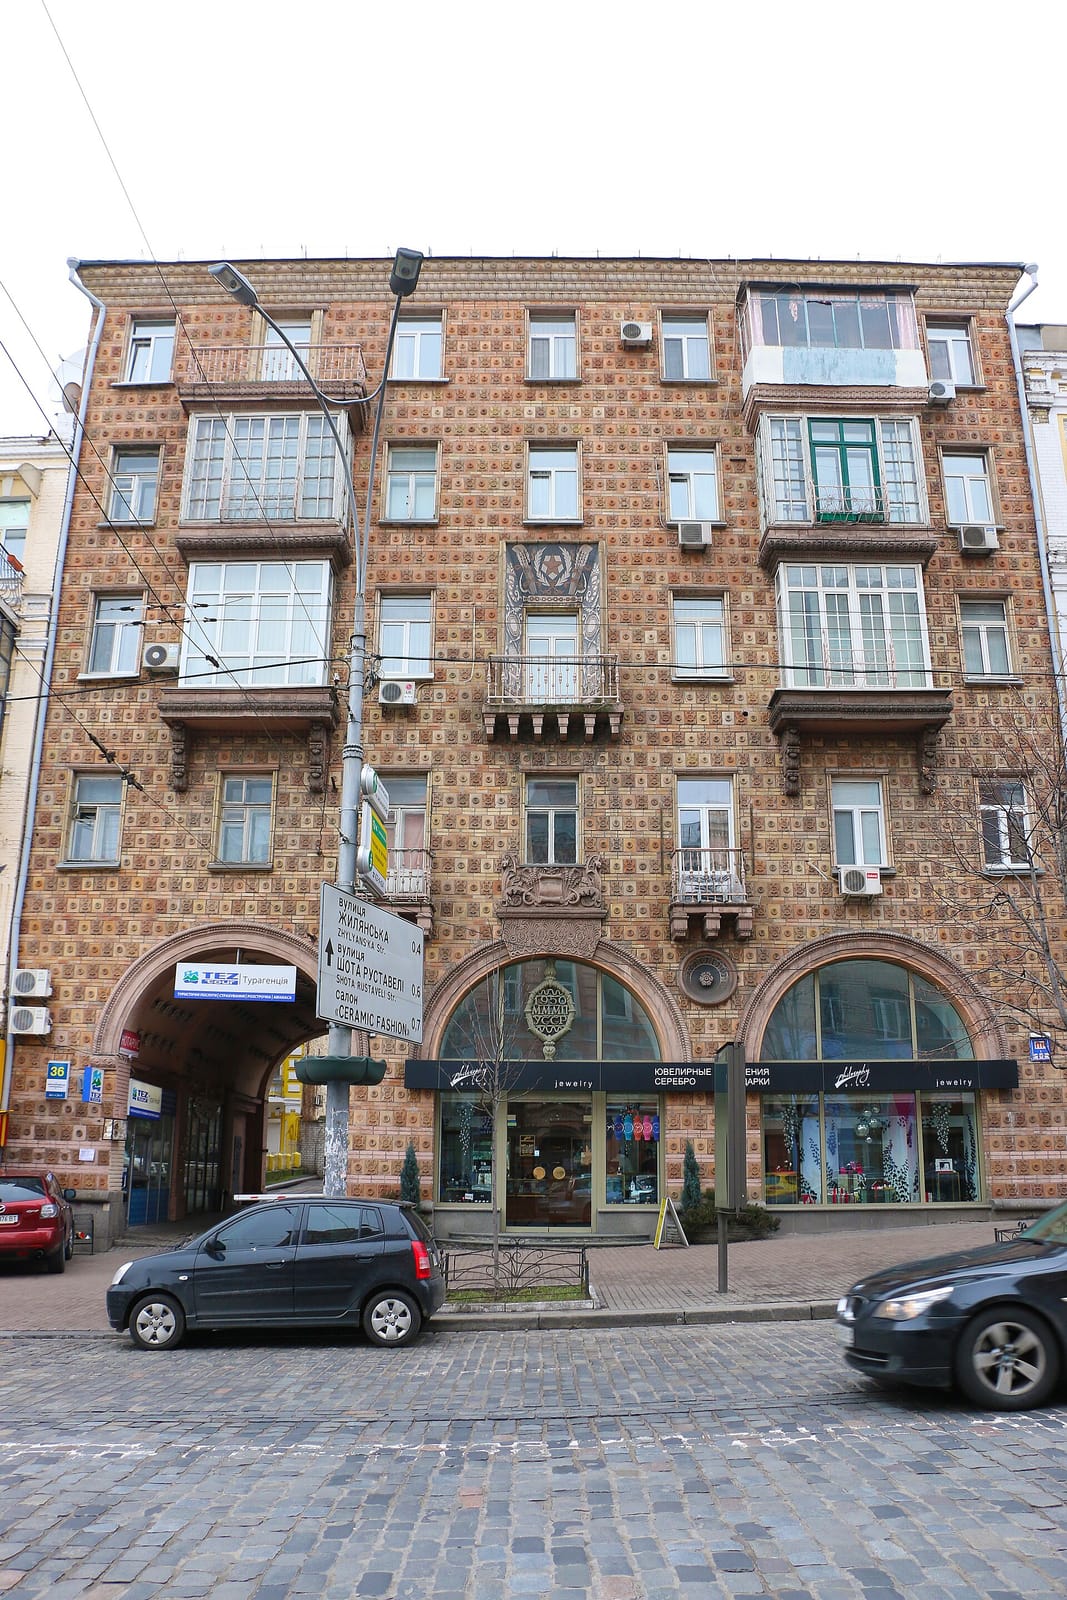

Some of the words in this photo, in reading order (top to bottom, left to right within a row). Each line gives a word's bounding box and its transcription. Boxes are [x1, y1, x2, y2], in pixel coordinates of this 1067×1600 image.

[338, 897, 366, 916] вулиця
[338, 911, 390, 944] ЖИЛЯНСЬКА
[337, 943, 365, 962] вулиця
[202, 971, 239, 980] TEZ
[336, 957, 362, 978] ШОТА
[363, 968, 405, 992] РУСТАВЕЛІ
[242, 975, 288, 986] Турагенція
[336, 974, 355, 989] SHOTA
[357, 981, 386, 999] RUSTAVELI
[335, 989, 358, 1005] салон
[532, 1014, 567, 1025] УССР
[50, 1066, 65, 1077] 36
[654, 1067, 712, 1076] ЮВЕЛИРНЫЕ
[745, 1067, 770, 1076] ЕНИЯ
[554, 1079, 593, 1089] jewelry
[654, 1077, 697, 1086] СЕРЕБРО
[744, 1077, 770, 1086] АРКИ
[936, 1078, 973, 1087] jewelry
